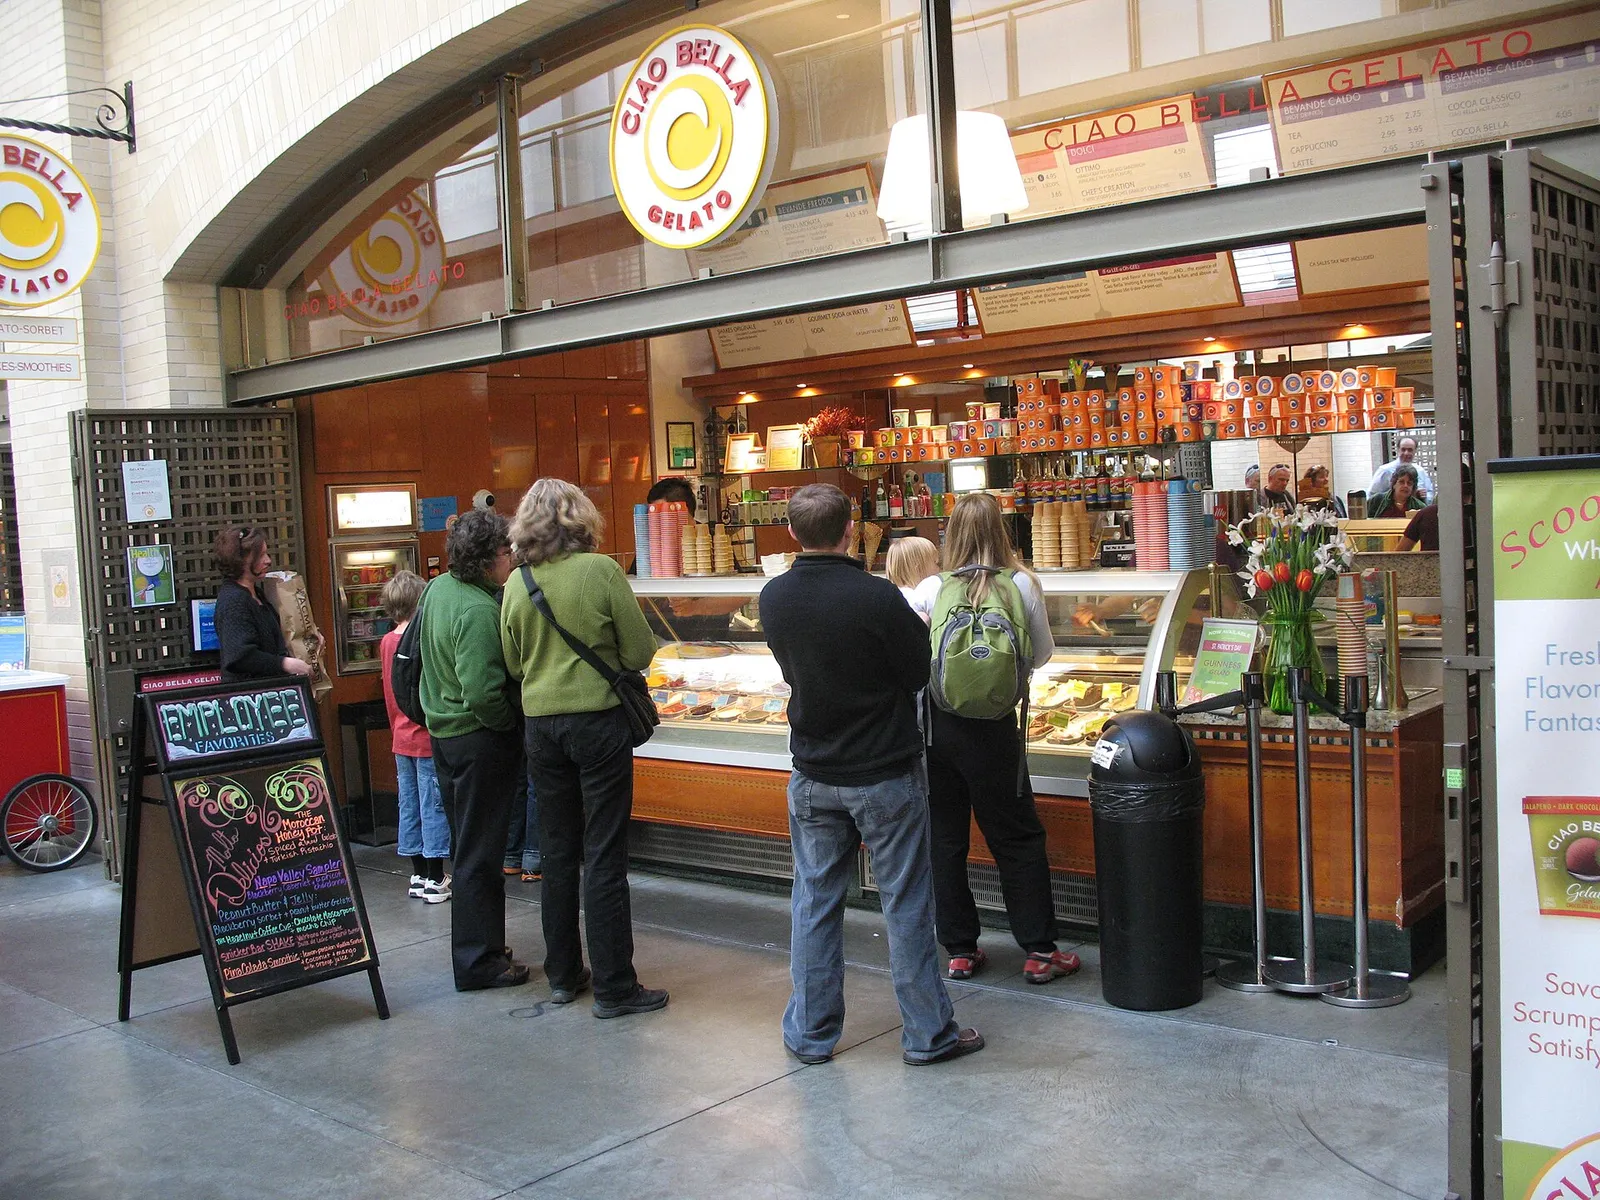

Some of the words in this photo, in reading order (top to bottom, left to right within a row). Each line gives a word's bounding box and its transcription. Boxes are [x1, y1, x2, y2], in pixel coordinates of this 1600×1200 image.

[1444, 67, 1492, 84] BEVANDE
[1496, 58, 1534, 73] CALDO
[622, 57, 667, 134] CIAO
[676, 38, 751, 105] BELLA
[1044, 113, 1136, 150] CIAO
[1161, 80, 1302, 128] BELLA
[1328, 30, 1533, 94] GELATO
[1284, 99, 1326, 115] BEVANDE
[1328, 92, 1361, 106] CALDO
[1448, 99, 1478, 112] COCOA
[1480, 90, 1522, 106] CLASSICO
[1378, 114, 1394, 124] 2.25
[1288, 132, 1302, 140] TEA
[1381, 130, 1396, 139] 2.95
[1451, 126, 1481, 138] COCOA
[1483, 120, 1510, 132] BELLA
[1070, 146, 1095, 157] DOLCI
[1290, 140, 1338, 154] CAPPUCCINO
[1383, 144, 1398, 153] 2.95
[1075, 164, 1101, 174] OTTIMO
[1292, 158, 1314, 168] LATTE
[3, 144, 83, 212] BELLA
[1081, 187, 1103, 197] CHEF'S
[1104, 181, 1135, 193] CREATION
[648, 190, 732, 231] GELATO
[778, 202, 806, 215] BEVANDE
[808, 196, 833, 208] FREDDO
[283, 299, 320, 320] CIAO
[326, 284, 382, 310] BELLA
[390, 261, 466, 294] GELATO
[808, 314, 832, 323] GOURMET
[832, 312, 846, 320] SODA
[852, 308, 869, 316] WATER
[0, 361, 72, 373] ES-SMOOTHIES
[131, 548, 160, 558] Health
[1222, 630, 1251, 638] AVAILABLE
[1218, 642, 1234, 650] PATRICK'S
[1204, 660, 1242, 670] GUINNESS
[160, 689, 306, 742] EMPLOYEE
[195, 731, 276, 753] FAVORITES
[294, 810, 312, 818] THE
[282, 815, 326, 830] Moroccan
[276, 828, 305, 844] Honey
[1548, 822, 1579, 850] CIAO
[268, 841, 296, 856] Spiced
[270, 851, 299, 864] Turkish
[300, 842, 334, 856] Pistachio
[254, 874, 277, 890] Napa
[277, 869, 305, 884] Valley
[213, 918, 256, 935] Blackberry
[258, 912, 283, 924] sorbet
[290, 905, 310, 918] peanut
[311, 901, 331, 911] butter
[218, 906, 250, 922] Peanut
[250, 900, 281, 915] Butter
[226, 930, 258, 946] Hazelnut
[259, 924, 278, 938] Coffee
[294, 914, 322, 926] Chocolate
[323, 906, 356, 920] Mascarpone
[296, 923, 320, 934] mocha
[320, 918, 337, 928] Chip
[252, 942, 266, 954] Bar
[265, 936, 295, 951] SHAKE
[336, 948, 356, 958] mango
[242, 960, 268, 974] Colada
[316, 958, 334, 968] orange
[334, 954, 348, 966] juice
[1514, 1002, 1600, 1036] Scrump
